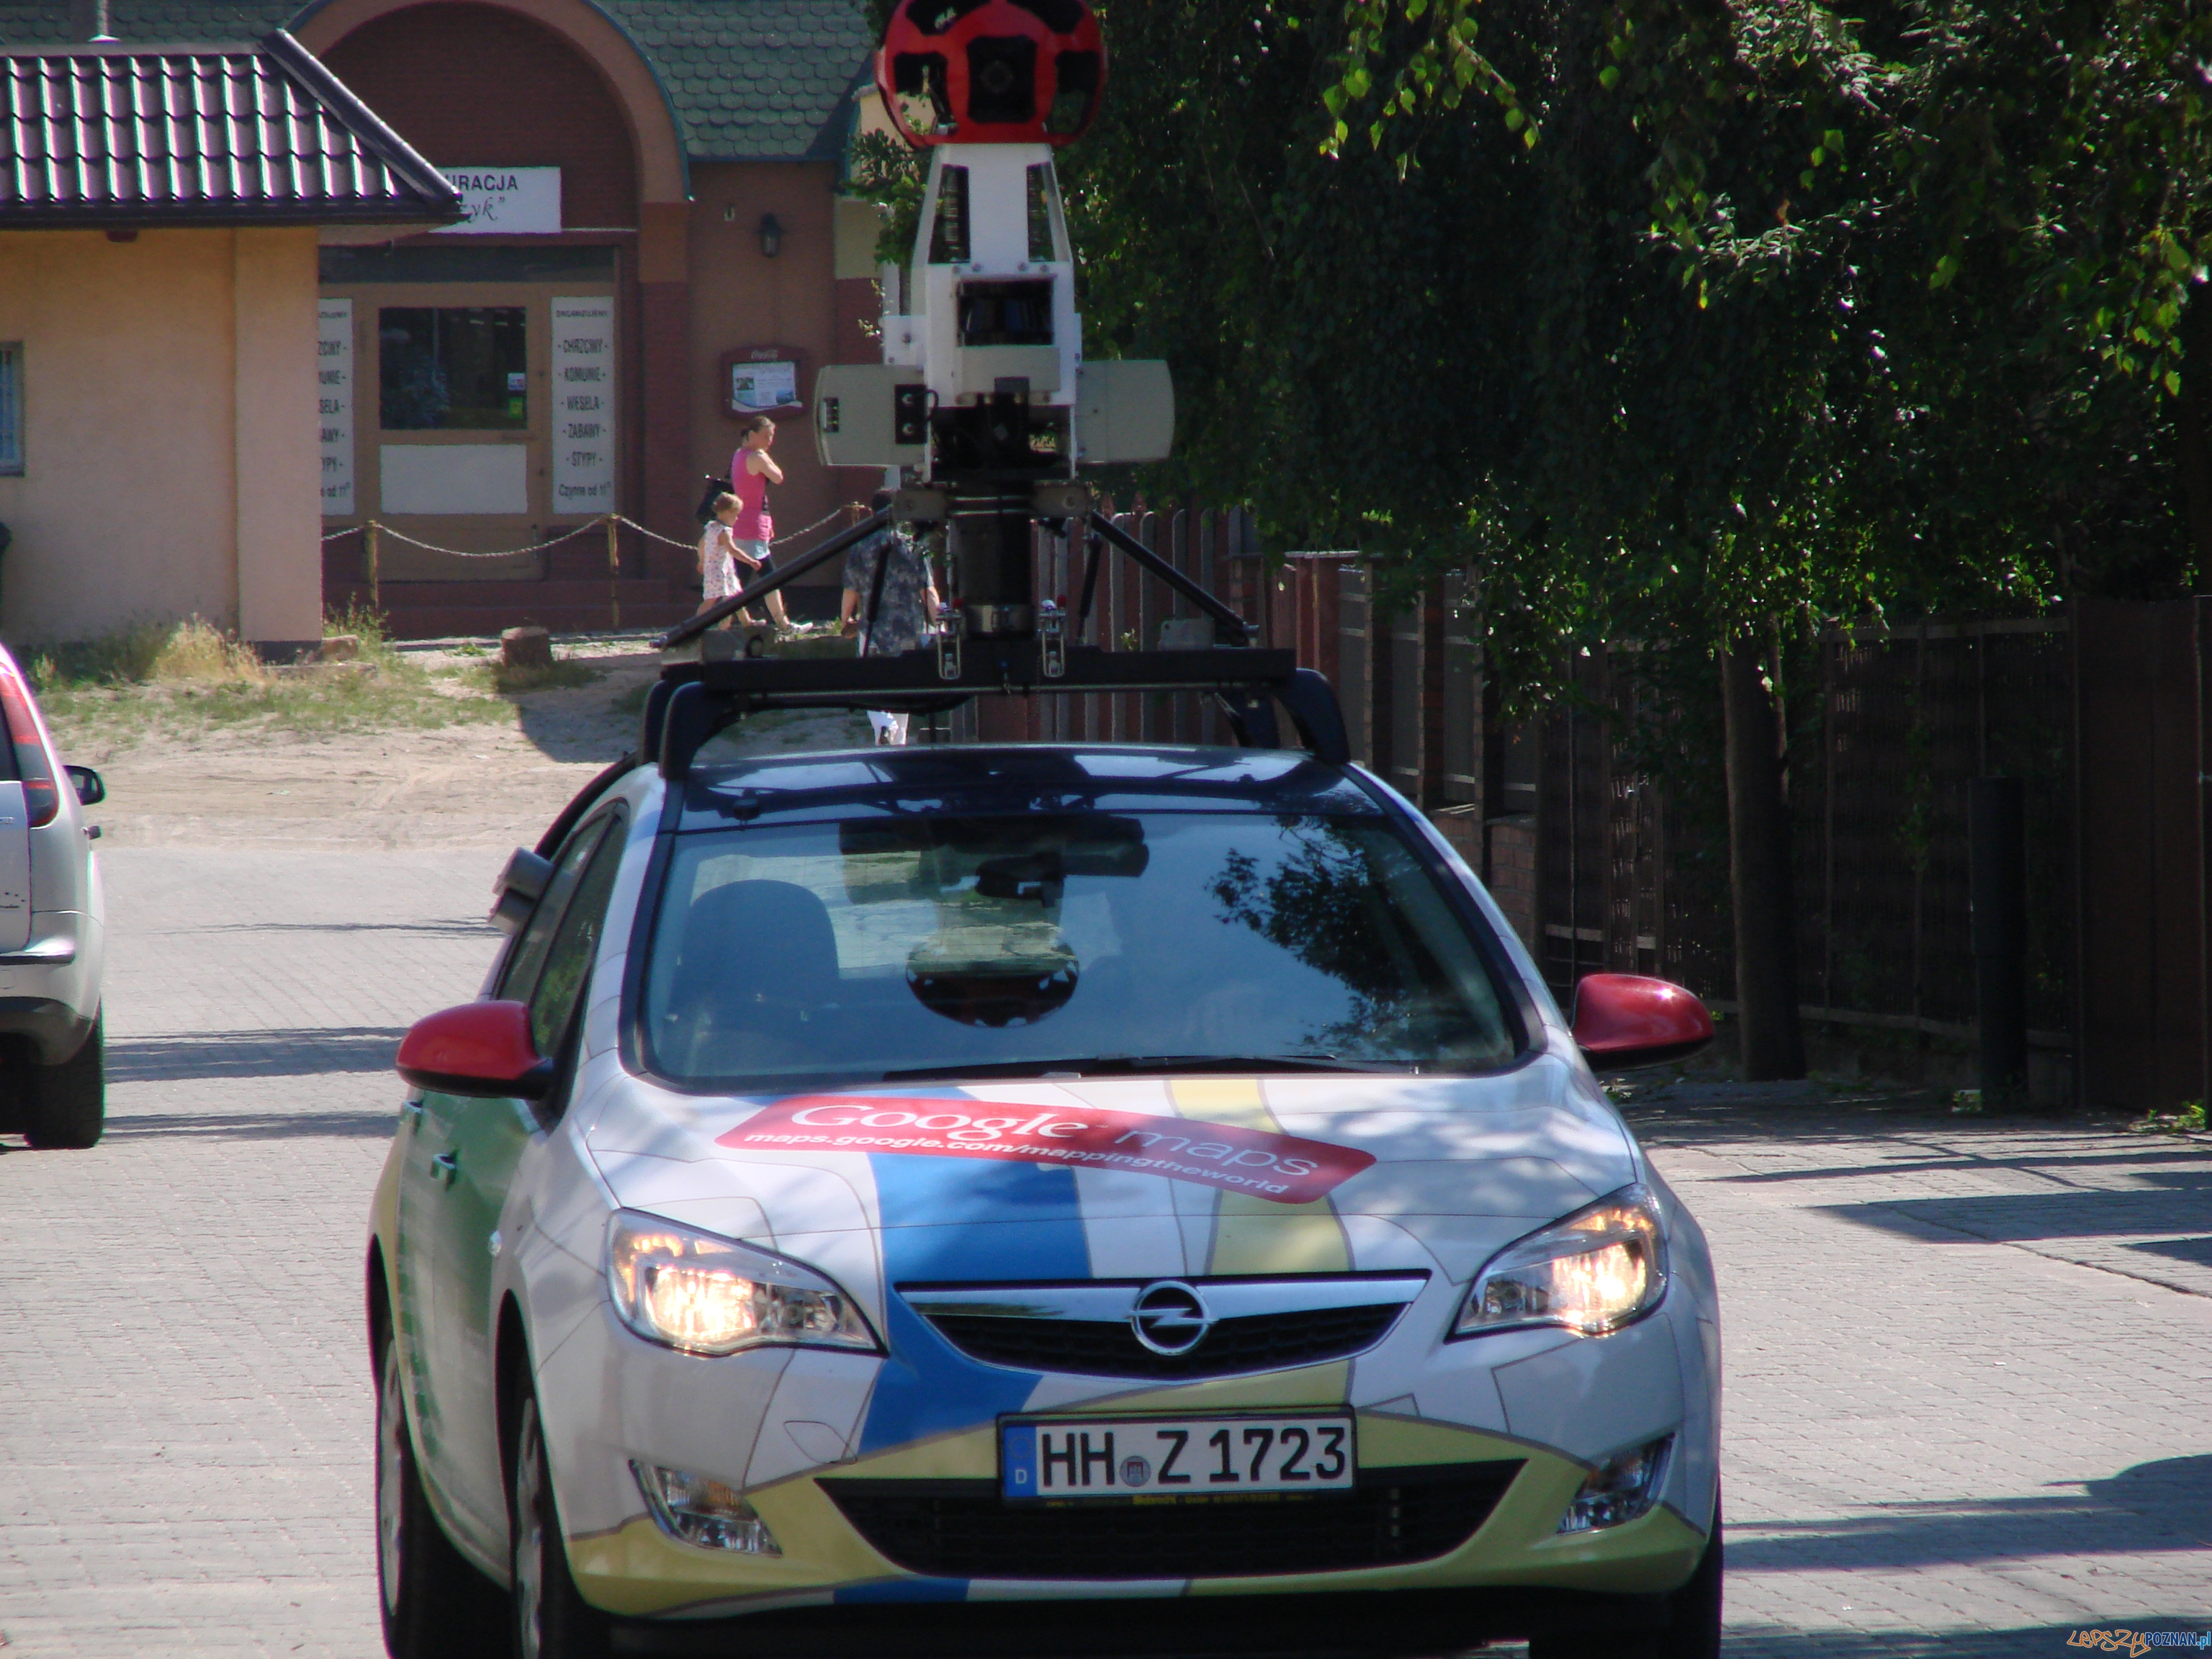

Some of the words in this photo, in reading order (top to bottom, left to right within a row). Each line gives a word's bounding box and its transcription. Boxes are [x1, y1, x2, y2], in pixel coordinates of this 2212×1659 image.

[745, 1133, 1289, 1195] maps.google.com/mappingtheworld
[791, 1105, 1088, 1142] Google
[1114, 1130, 1318, 1177] maps
[1015, 1469, 1027, 1485] D
[1041, 1431, 1115, 1486] HH
[1156, 1429, 1191, 1484] Z
[1209, 1426, 1345, 1483] 1723
